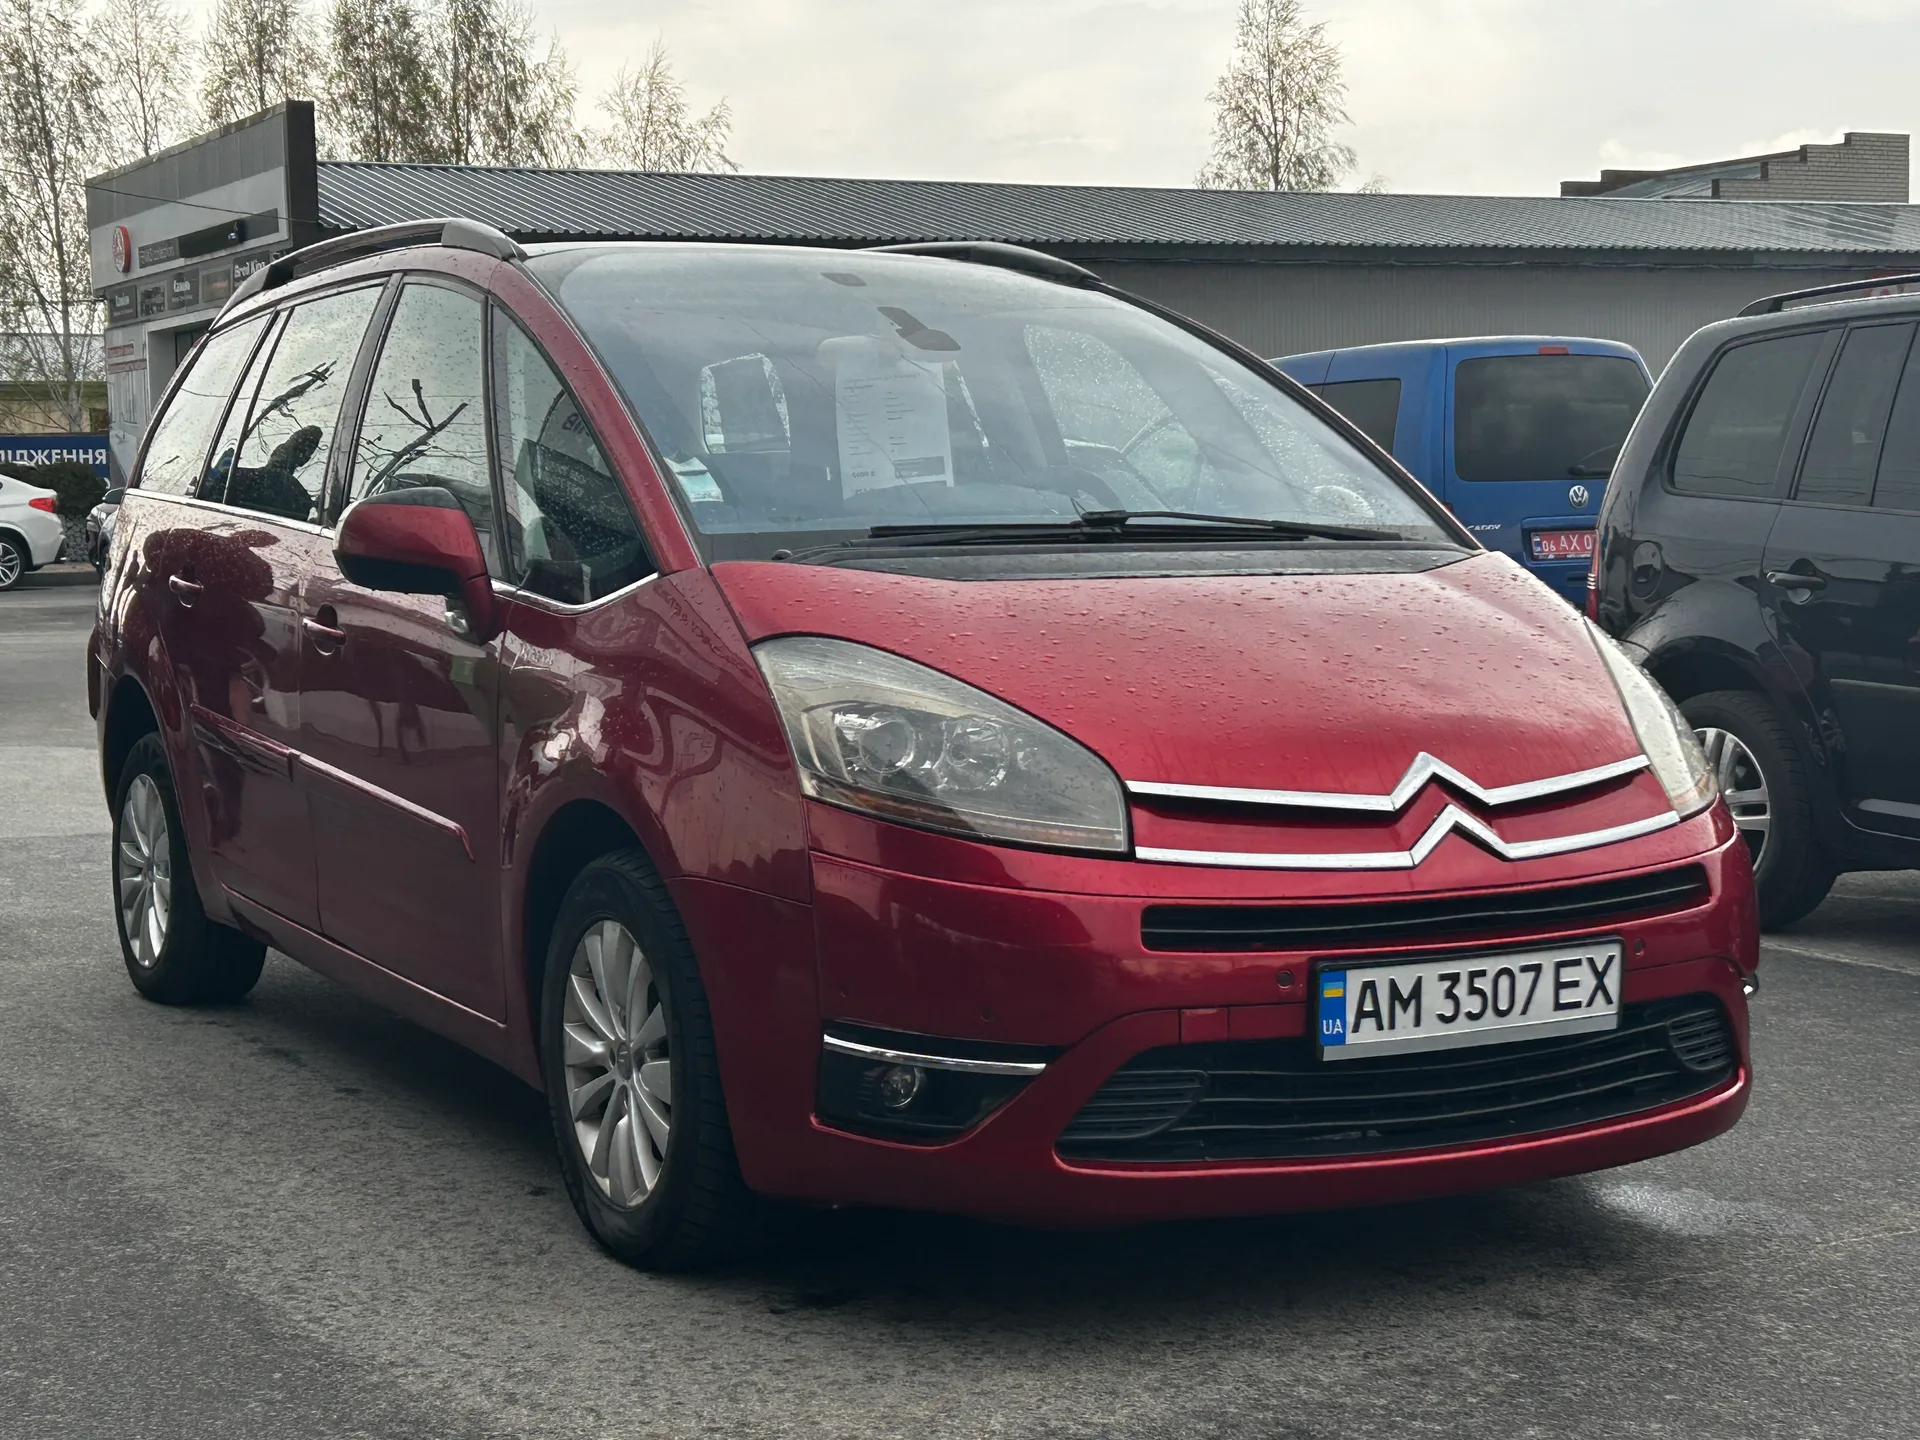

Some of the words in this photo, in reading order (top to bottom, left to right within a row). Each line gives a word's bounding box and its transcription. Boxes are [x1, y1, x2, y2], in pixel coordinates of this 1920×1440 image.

[1541, 540, 1556, 552] 06
[1560, 534, 1580, 551] AX
[1322, 1018, 1344, 1035] UA
[1351, 974, 1423, 1034] AM
[1435, 962, 1543, 1024] 3507
[1552, 953, 1617, 1012] EX
